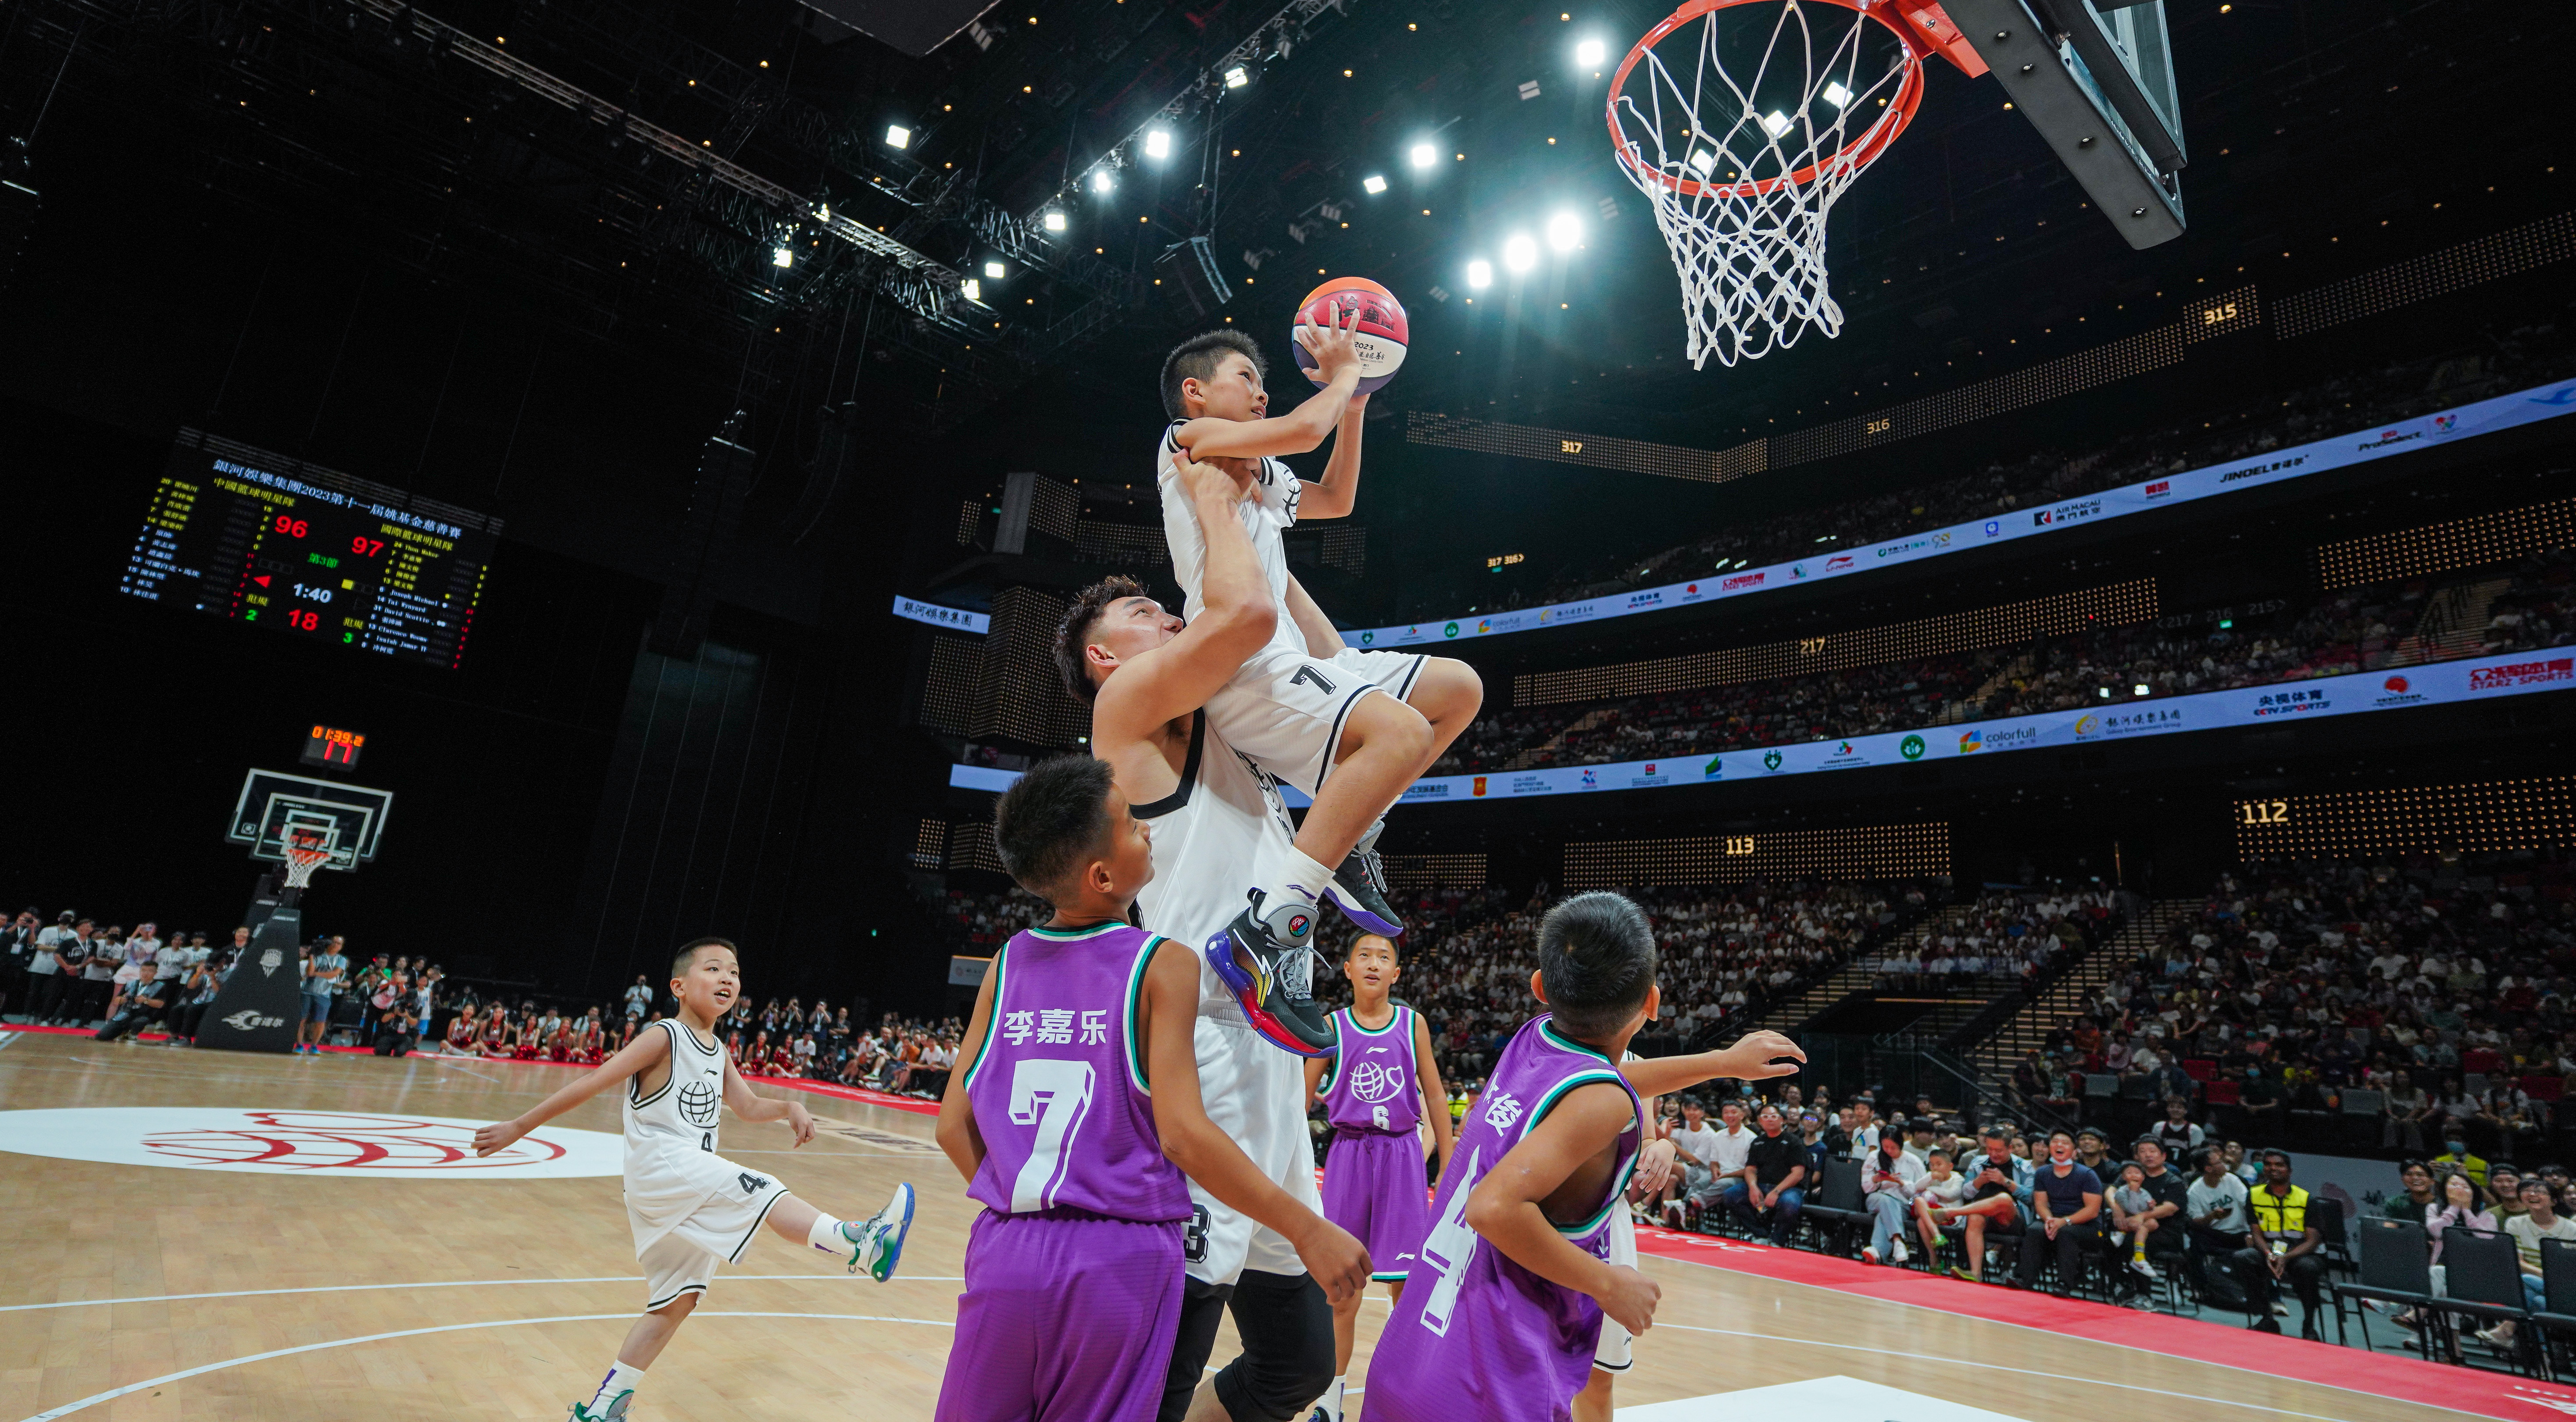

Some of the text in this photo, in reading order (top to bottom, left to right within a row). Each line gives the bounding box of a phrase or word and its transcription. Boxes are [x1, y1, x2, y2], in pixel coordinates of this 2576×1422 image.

[2204, 303, 2237, 325] 315
[1354, 342, 1374, 350] 2023
[1867, 418, 1890, 434] 316
[1561, 440, 1583, 453] 317
[2056, 499, 2101, 514] AIR MACAU
[275, 514, 308, 538] 96
[351, 536, 384, 557] 97
[1487, 556, 1503, 568] 317
[293, 583, 333, 604] 1:40
[245, 609, 258, 621] 2
[288, 608, 319, 632] 18
[343, 632, 354, 644] 3
[1800, 638, 1825, 654] 217
[1290, 665, 1337, 695] 7
[1986, 727, 2036, 743] colorfull
[2242, 802, 2289, 824] 112
[1726, 837, 1754, 855] 113
[1003, 1008, 1108, 1046] 李嘉乐
[1372, 1105, 1390, 1130] 6
[1008, 1058, 1096, 1213] 7
[737, 1172, 771, 1195] 4
